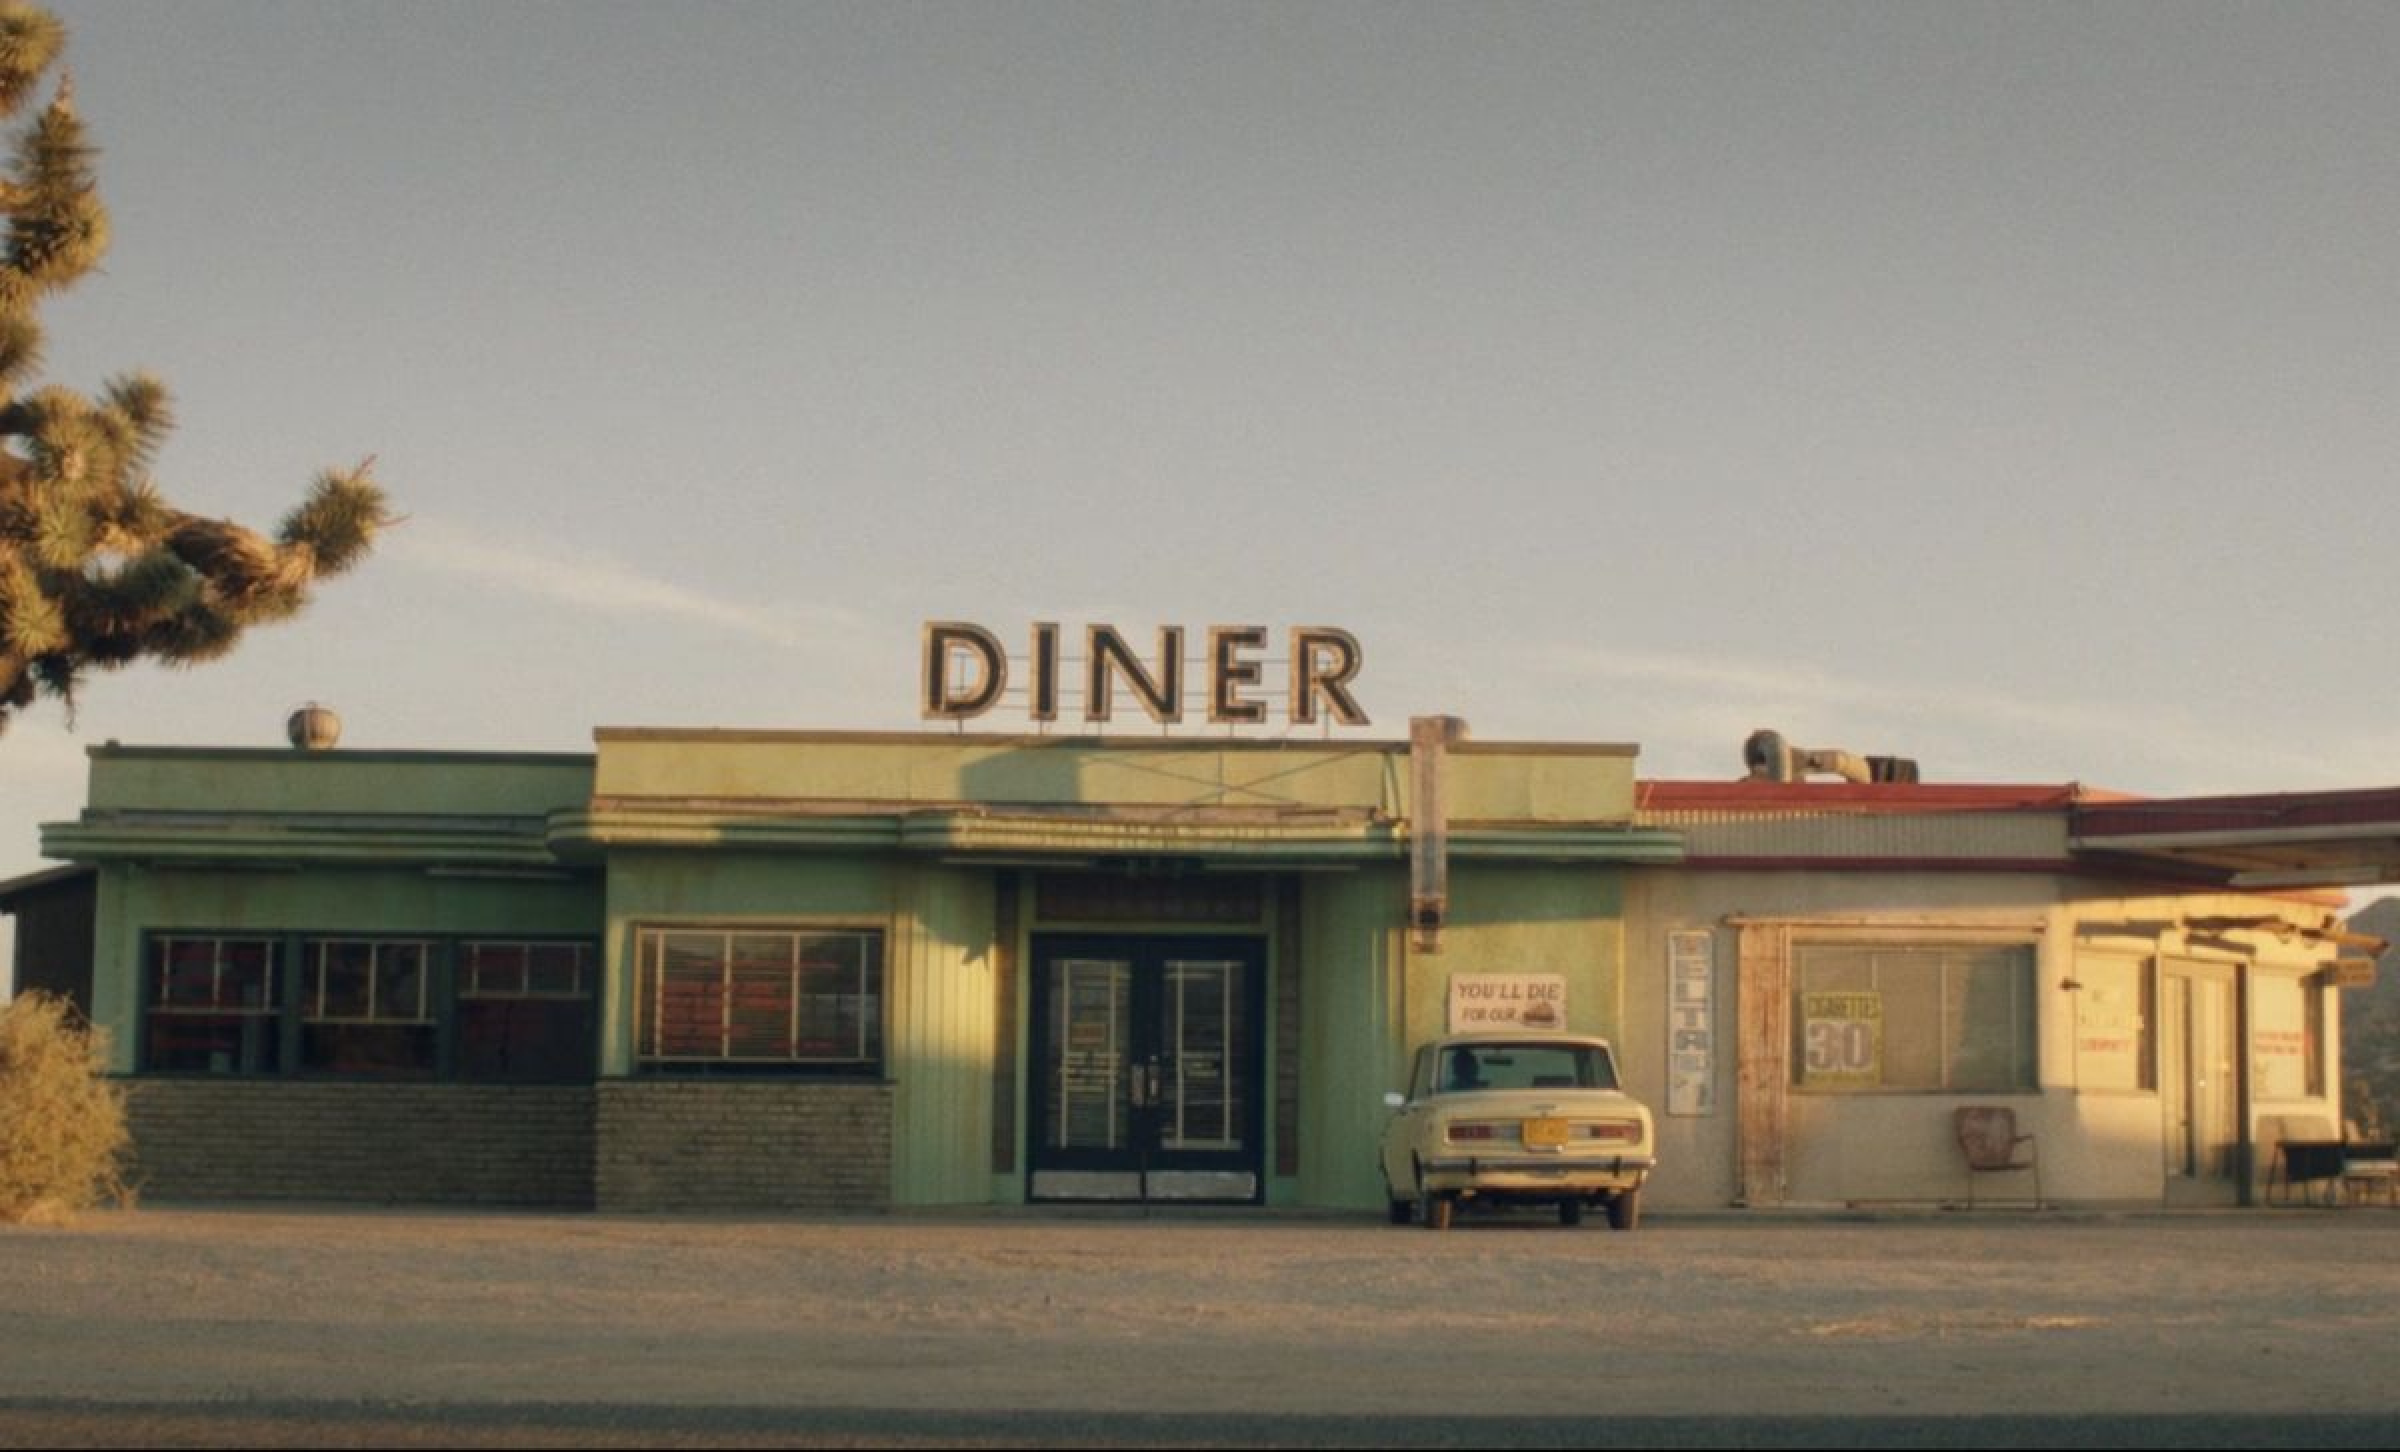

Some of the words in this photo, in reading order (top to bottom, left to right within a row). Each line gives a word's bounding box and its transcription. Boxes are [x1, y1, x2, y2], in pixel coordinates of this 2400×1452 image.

[922, 622, 1372, 725] DINER
[1458, 982, 1520, 998] YOU'LL
[1527, 983, 1560, 999] DIE
[1462, 1007, 1486, 1020] FOR
[1489, 1007, 1516, 1021] OUR
[1807, 1022, 1871, 1068] 30
